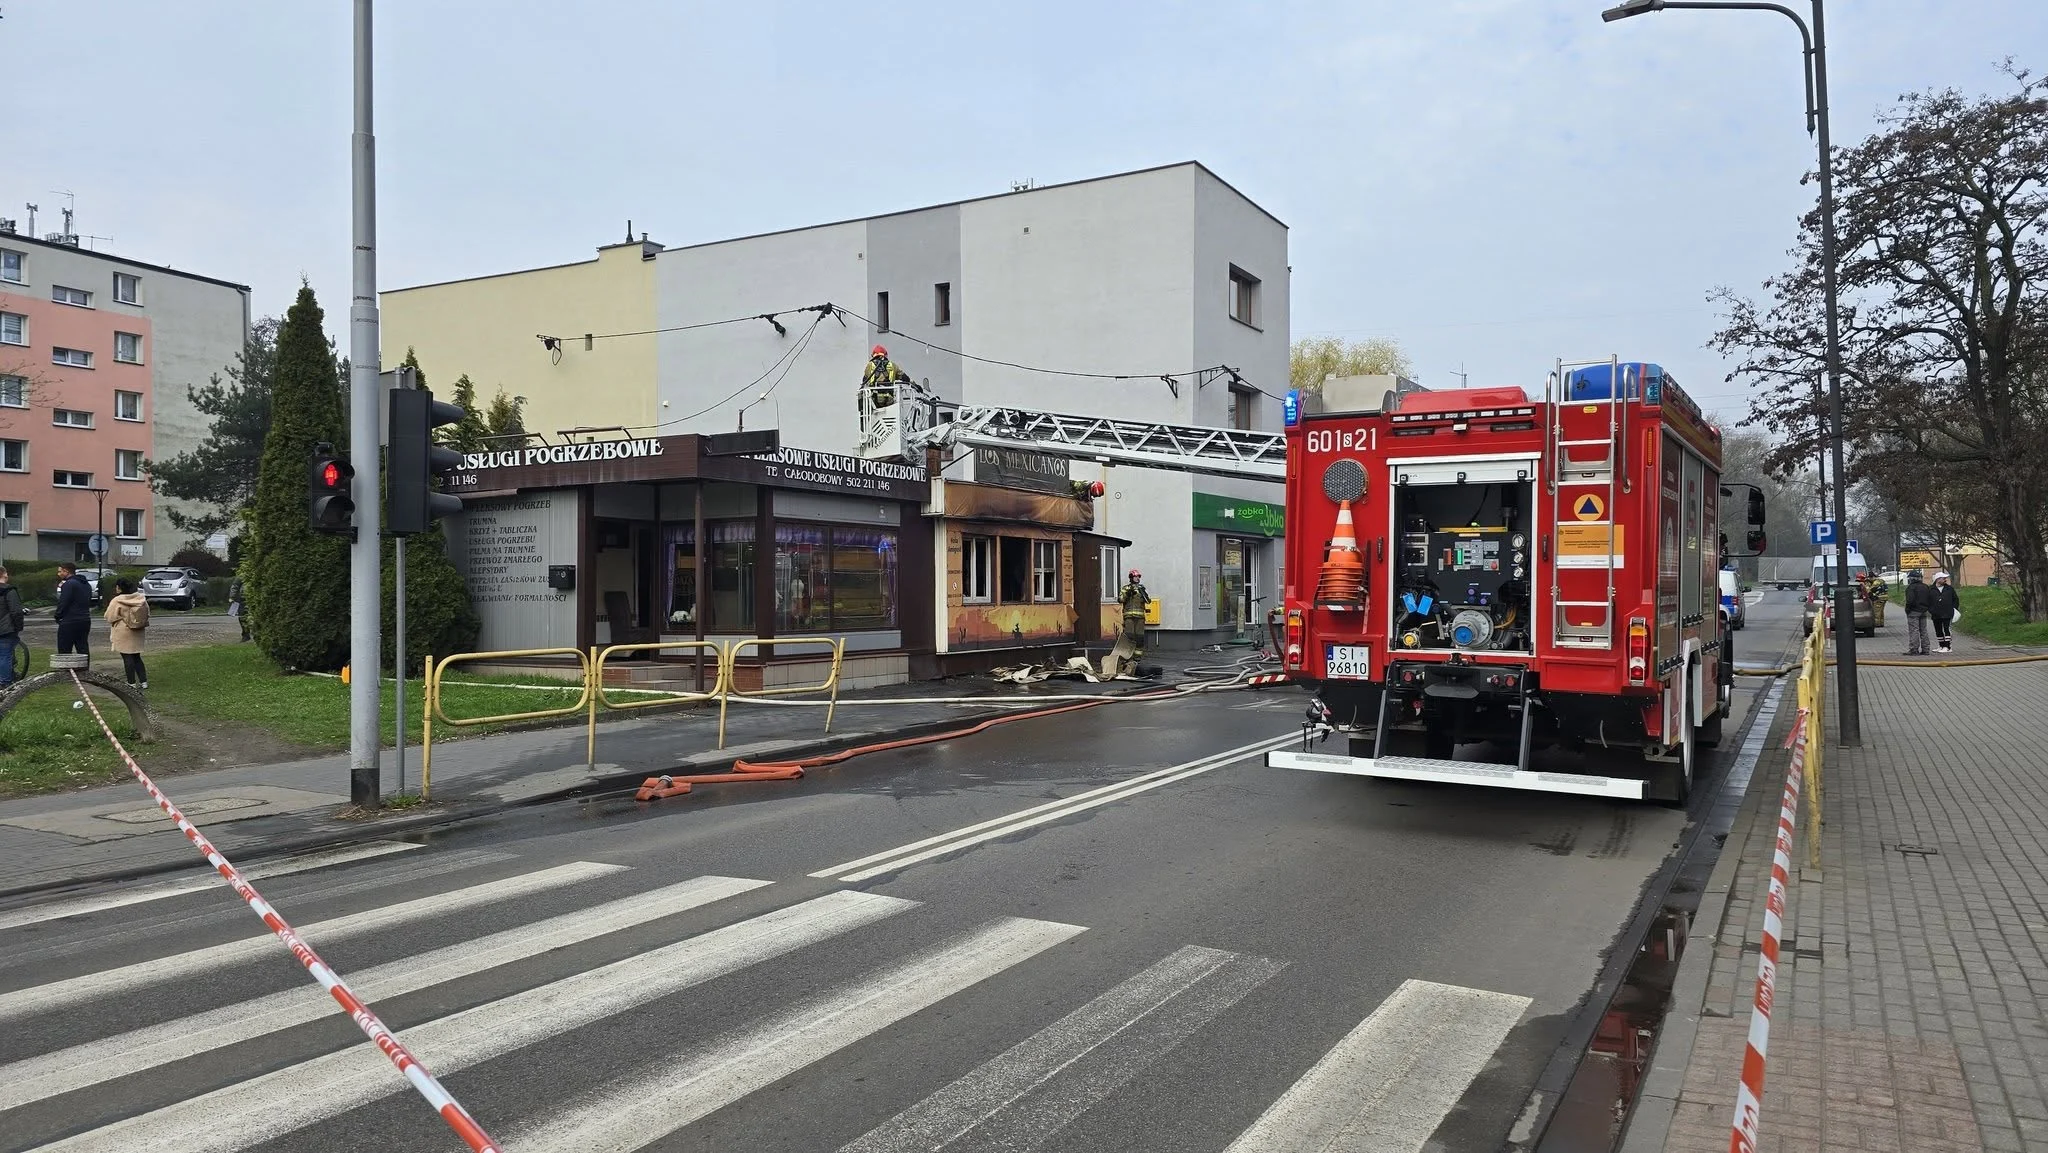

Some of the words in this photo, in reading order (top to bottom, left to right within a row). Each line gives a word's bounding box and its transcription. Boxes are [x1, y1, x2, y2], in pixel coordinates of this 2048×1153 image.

[1307, 428, 1342, 453] 601
[1354, 427, 1377, 451] 21
[524, 438, 665, 466] POGRZEBOWE
[814, 452, 856, 473] USŁUGI
[859, 459, 927, 482] POGRZEBOWE
[979, 448, 1000, 466] LOS
[1005, 451, 1067, 477] MEXICANOS
[462, 474, 477, 485] 146
[784, 468, 843, 486] CAŁODOBOWY
[846, 477, 861, 488] 502
[863, 478, 875, 489] 211
[877, 480, 890, 491] 146
[513, 500, 551, 511] POGRZEB
[1237, 507, 1264, 517] żabka
[469, 517, 497, 526] TRUMNA
[469, 525, 491, 535] KRZYŻ
[499, 525, 538, 535] TABLICZKA
[1816, 523, 1832, 542] P
[497, 535, 536, 545] POGRZEBU
[491, 546, 502, 555] NA
[503, 545, 536, 555] TRUMNIE
[503, 555, 543, 564] ZMARŁEGO
[1339, 647, 1355, 660] SI
[1328, 661, 1368, 675] 96810
